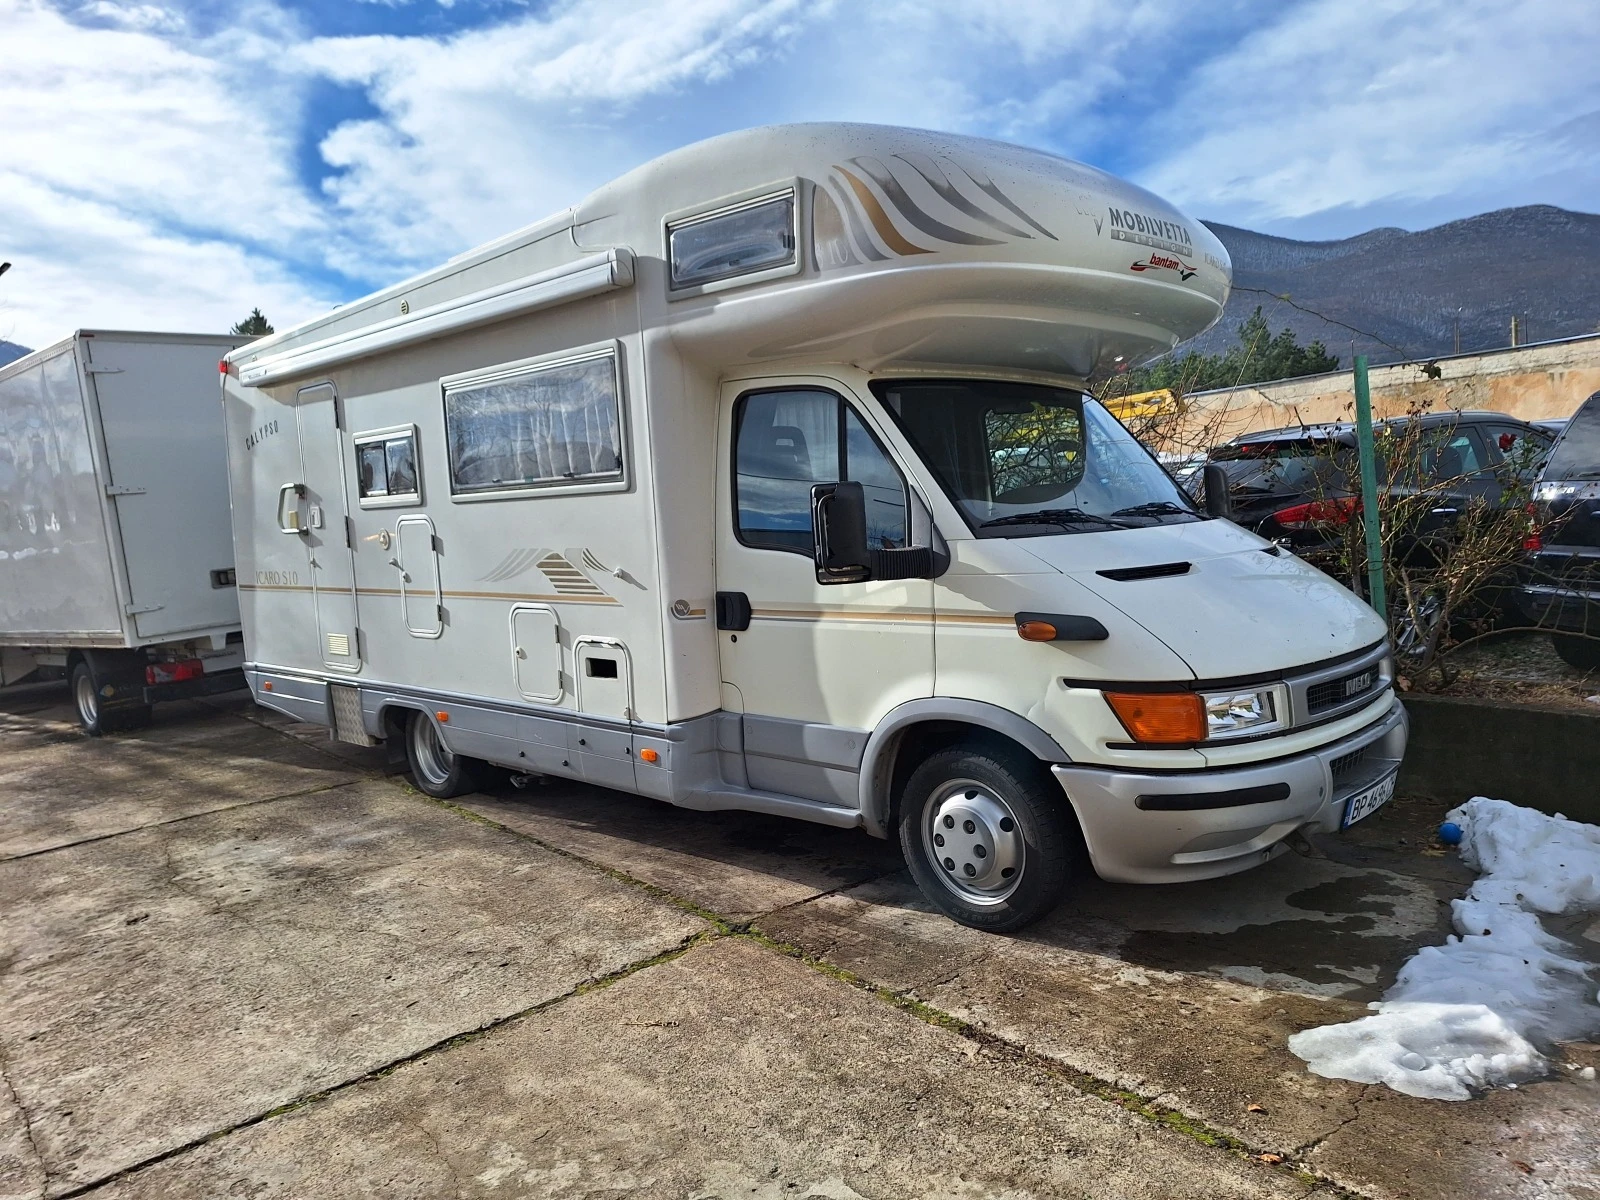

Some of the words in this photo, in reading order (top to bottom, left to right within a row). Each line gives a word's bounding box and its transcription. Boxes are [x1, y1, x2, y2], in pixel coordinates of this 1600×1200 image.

[1109, 207, 1192, 246] MOBILVETTA
[1149, 252, 1180, 271] bantam
[245, 420, 279, 451] CALYPSO
[255, 570, 281, 585] ICARO
[1346, 672, 1371, 696] IVECO
